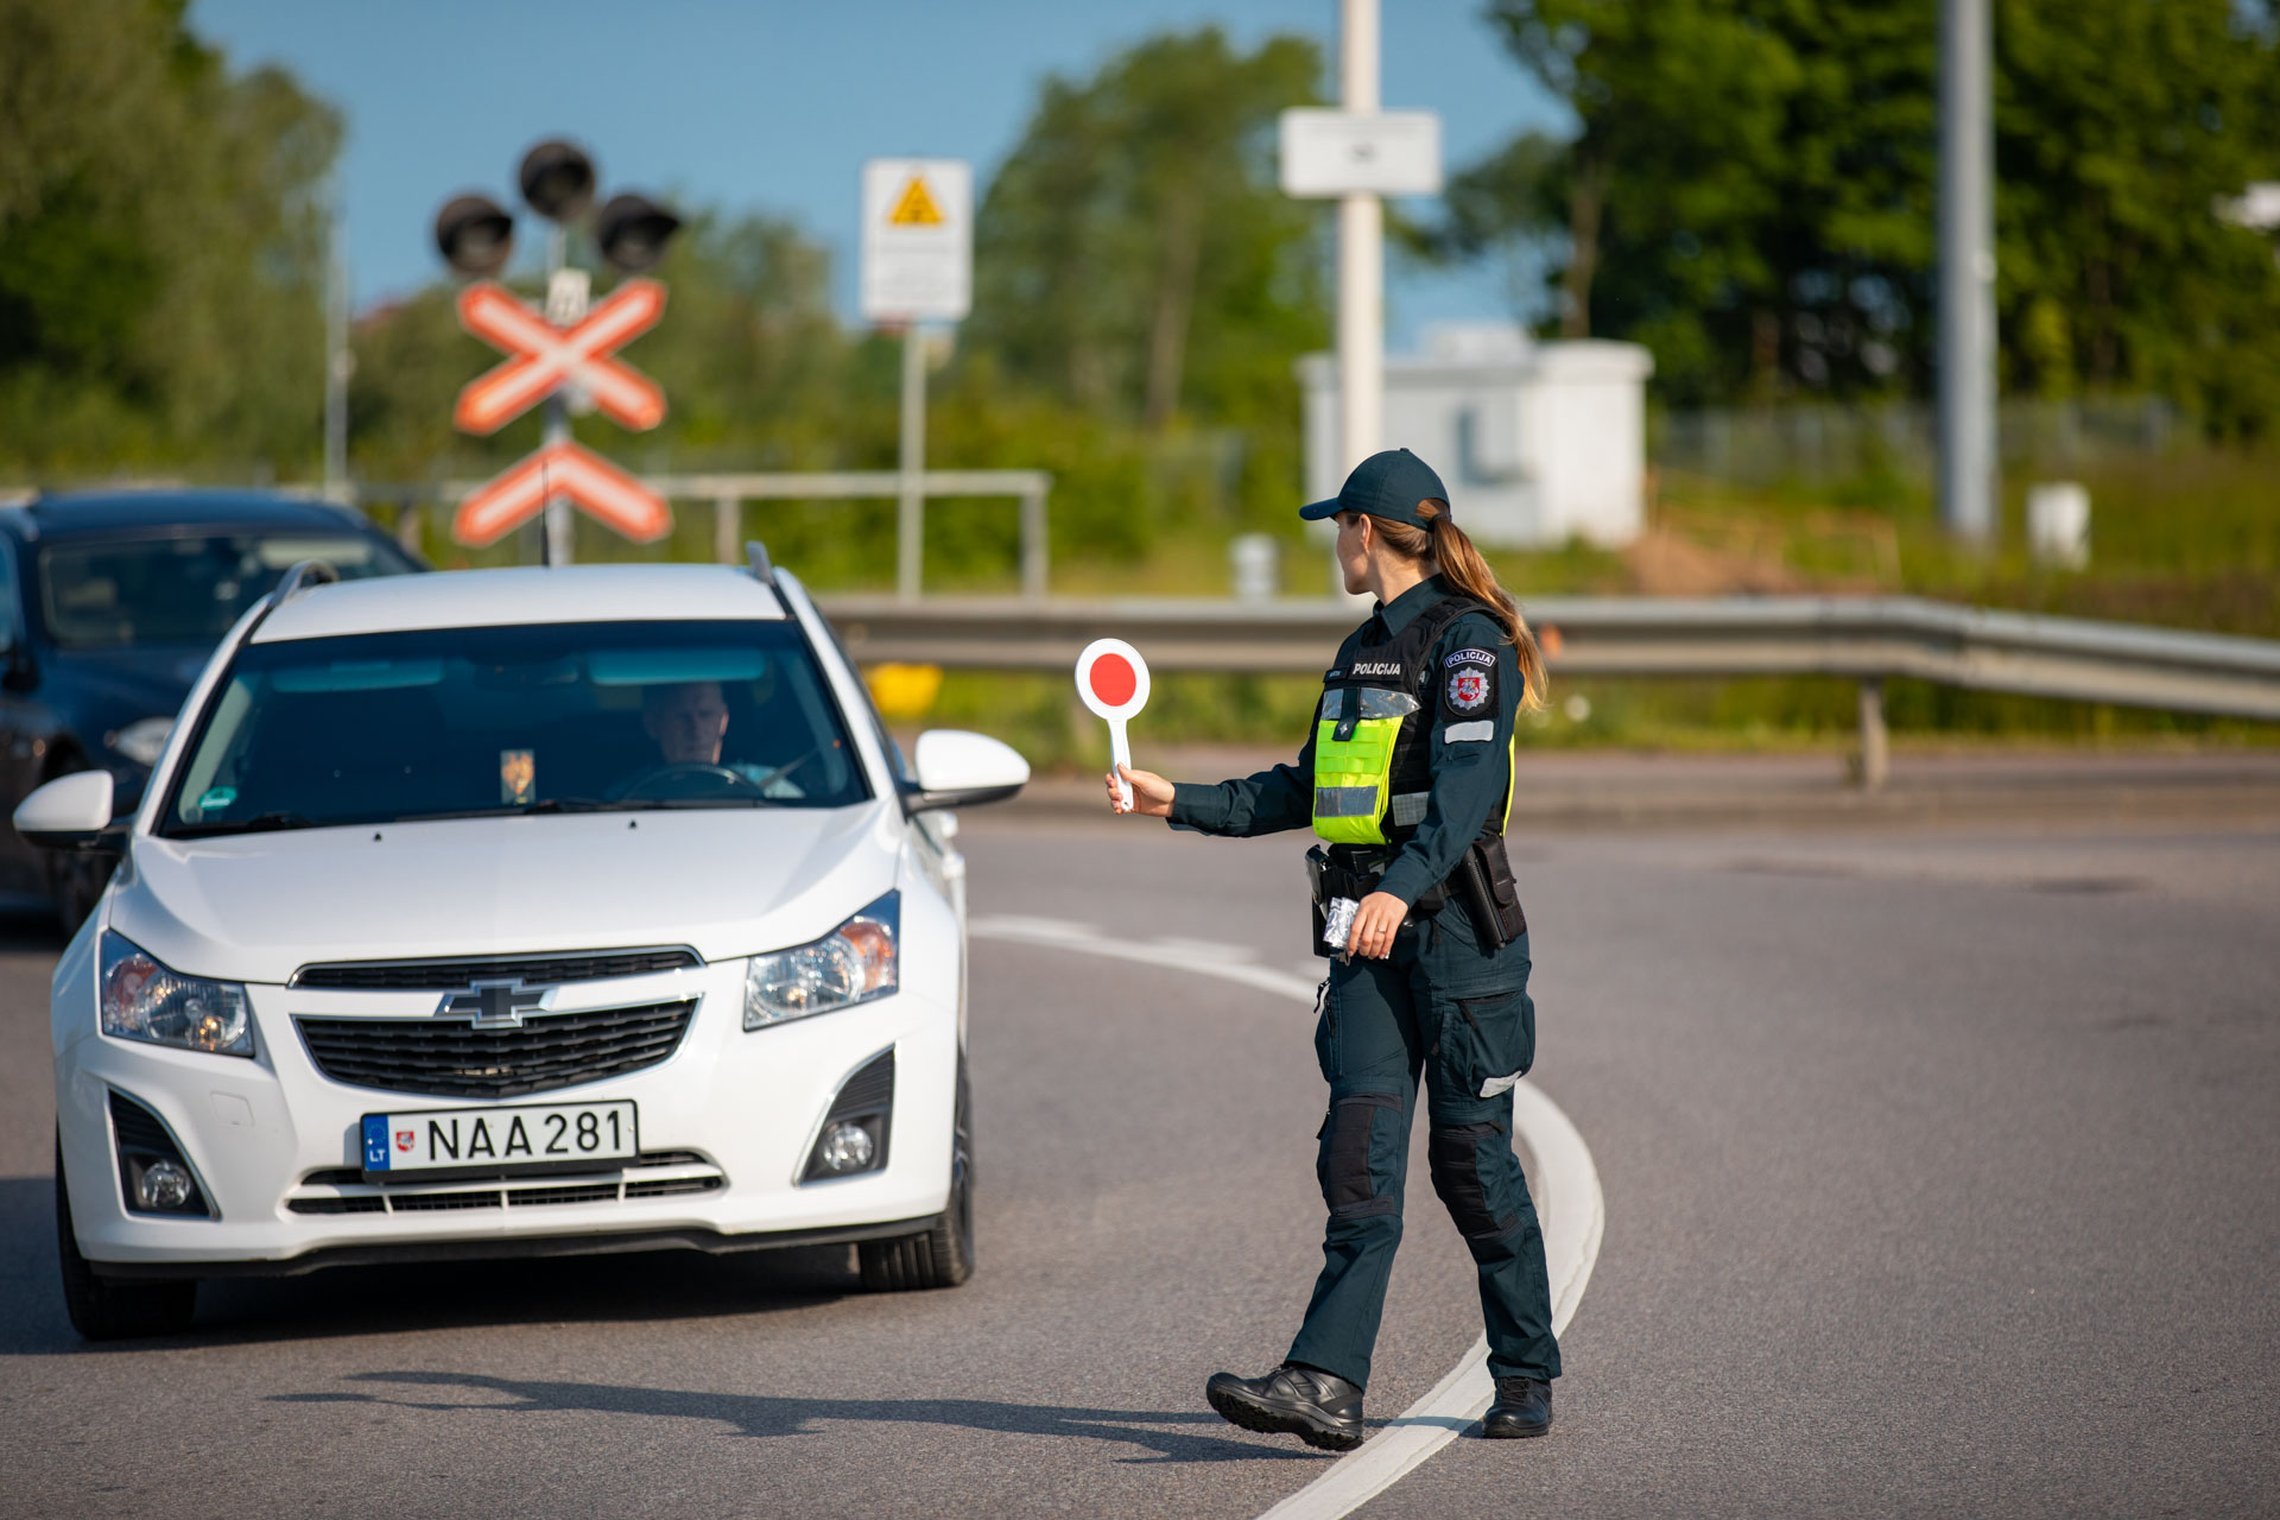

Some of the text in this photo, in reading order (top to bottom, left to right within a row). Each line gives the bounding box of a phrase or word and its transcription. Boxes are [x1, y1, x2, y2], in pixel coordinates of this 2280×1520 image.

[1449, 651, 1491, 664] POLICIJA
[1352, 663, 1400, 675] POLICIJA
[369, 1149, 386, 1162] LT
